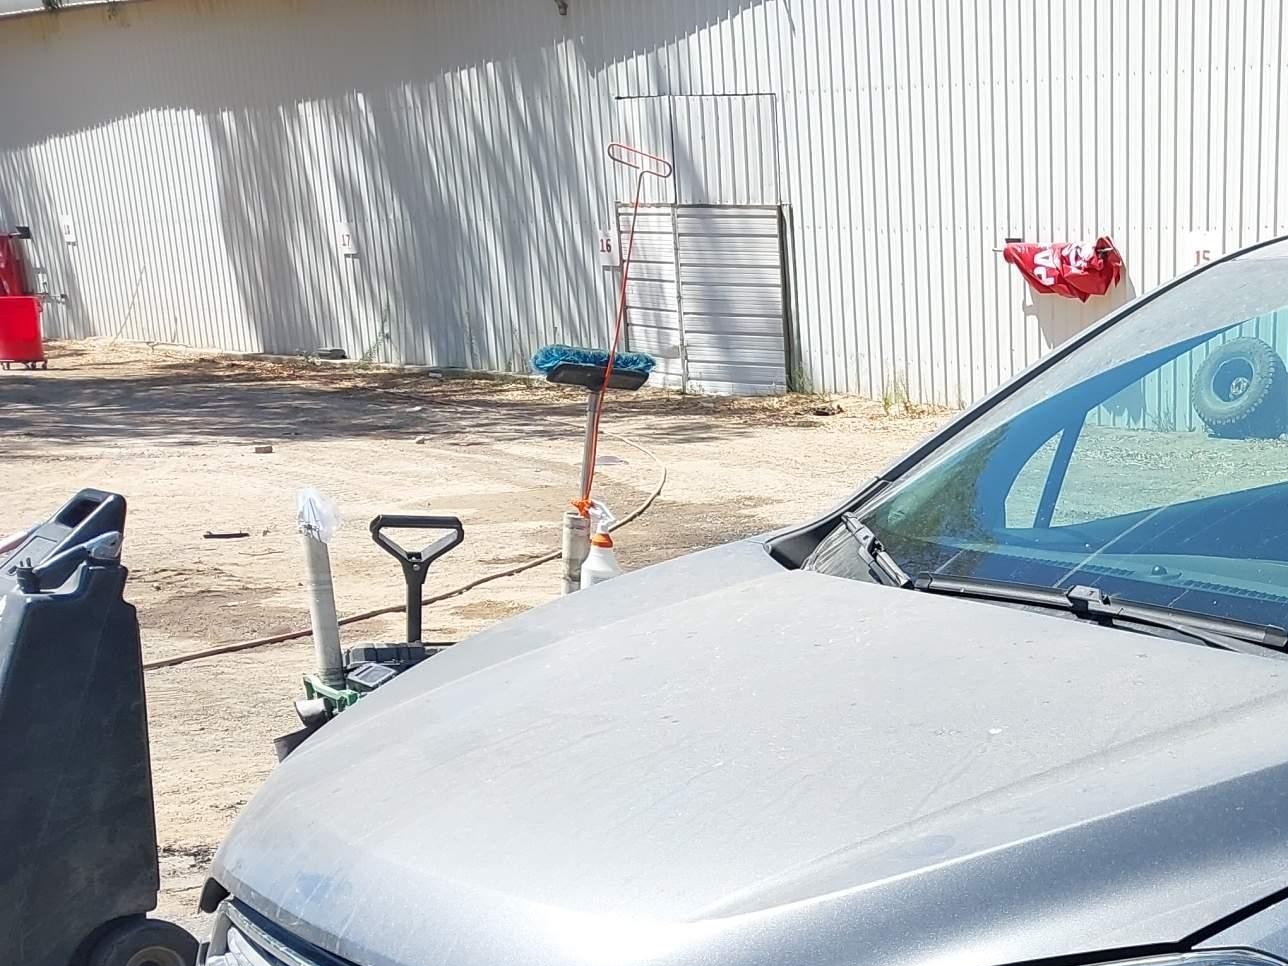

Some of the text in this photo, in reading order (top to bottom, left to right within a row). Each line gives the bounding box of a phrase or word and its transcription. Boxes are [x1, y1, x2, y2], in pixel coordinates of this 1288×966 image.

[342, 233, 351, 247] 17
[600, 238, 612, 253] 16
[1193, 250, 1211, 267] 15
